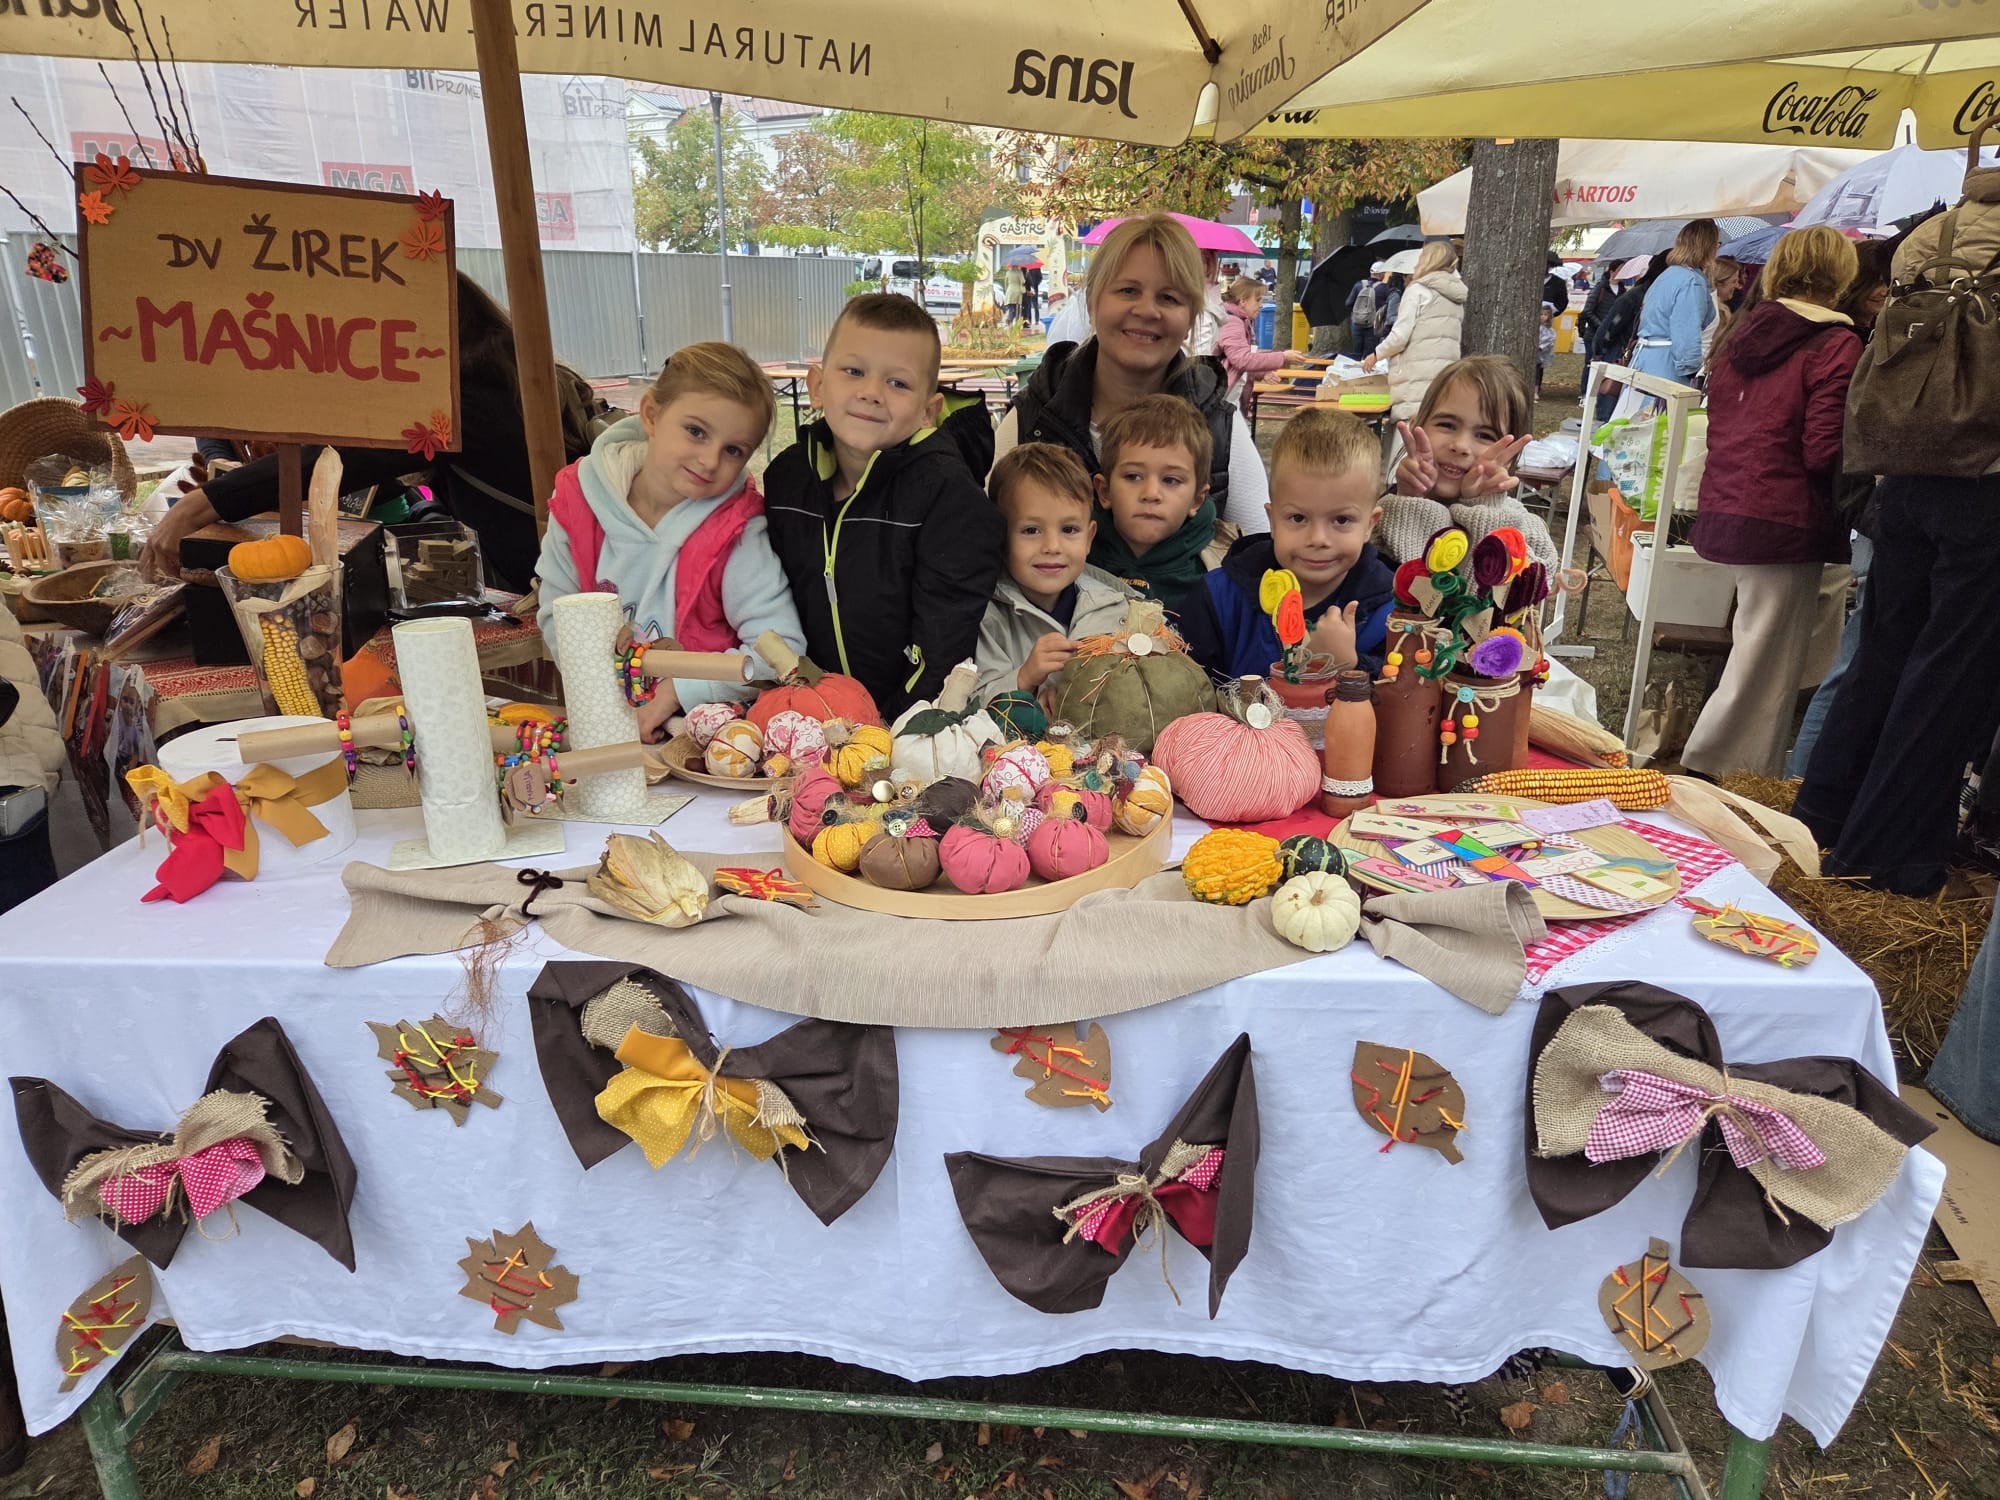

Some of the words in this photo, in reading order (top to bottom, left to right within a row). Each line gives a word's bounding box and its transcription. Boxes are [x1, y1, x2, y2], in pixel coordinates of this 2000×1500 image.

[1762, 81, 1881, 138] Coca-Cola
[331, 169, 407, 193] MGA
[1577, 185, 1638, 203] ARTOIS
[157, 232, 222, 270] DV
[243, 213, 406, 286] ŽIREK
